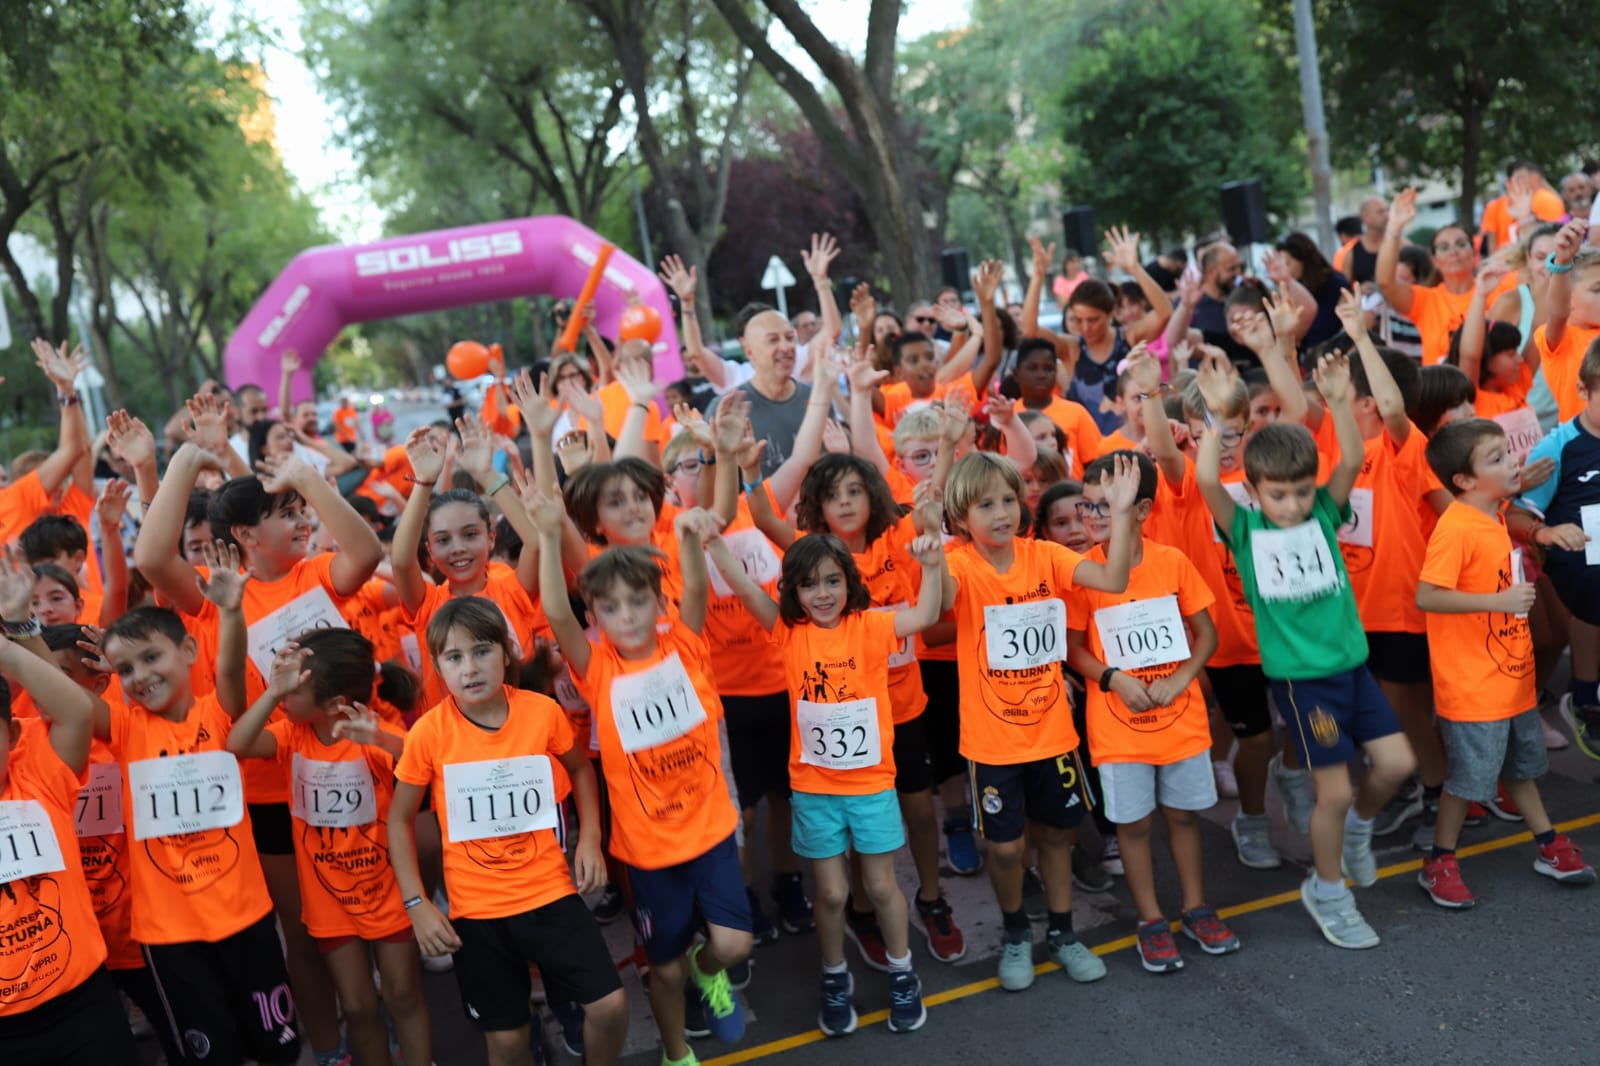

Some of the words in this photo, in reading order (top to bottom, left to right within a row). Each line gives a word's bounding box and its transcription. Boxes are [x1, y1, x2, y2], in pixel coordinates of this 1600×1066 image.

[355, 231, 523, 277] SOLISS
[1269, 544, 1324, 587] 334
[1001, 623, 1056, 659] 300
[1115, 624, 1173, 657] 1003
[987, 664, 1052, 679] NOCTURNA
[811, 725, 869, 759] 332
[1055, 752, 1077, 789] 5
[150, 783, 227, 819] 1112
[300, 784, 363, 814] 1129
[466, 787, 541, 823] 1110
[251, 983, 295, 1033] 10
